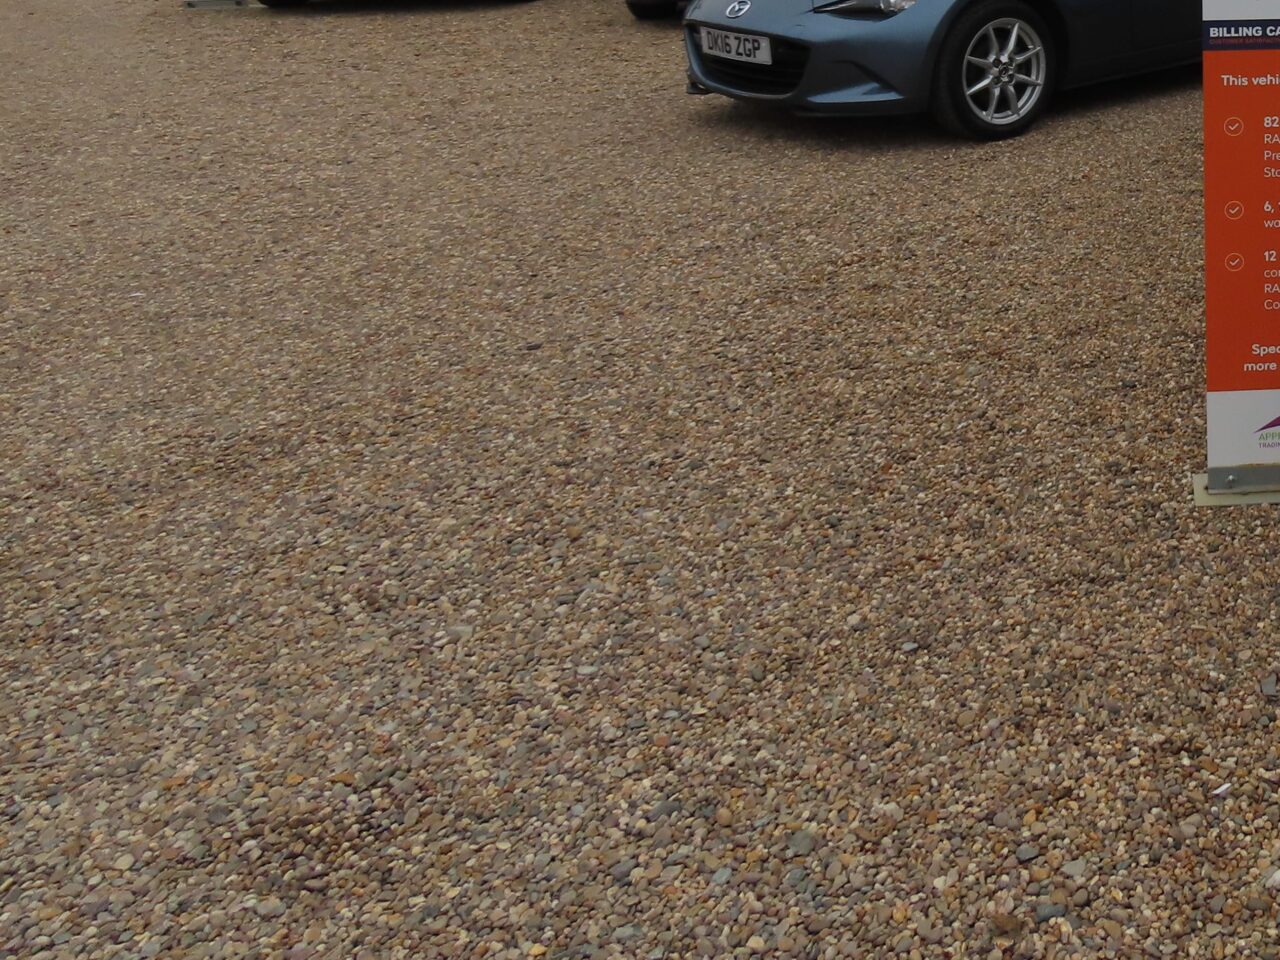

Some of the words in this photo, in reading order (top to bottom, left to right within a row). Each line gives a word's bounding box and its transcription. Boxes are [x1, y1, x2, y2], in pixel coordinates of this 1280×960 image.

[1209, 26, 1262, 38] BILLING
[706, 31, 732, 54] DK16
[734, 36, 761, 58] ZGP
[1221, 75, 1248, 86] This
[1263, 117, 1279, 128] 82
[1263, 201, 1274, 213] 6,
[1263, 251, 1277, 261] 12
[1244, 362, 1277, 372] more
